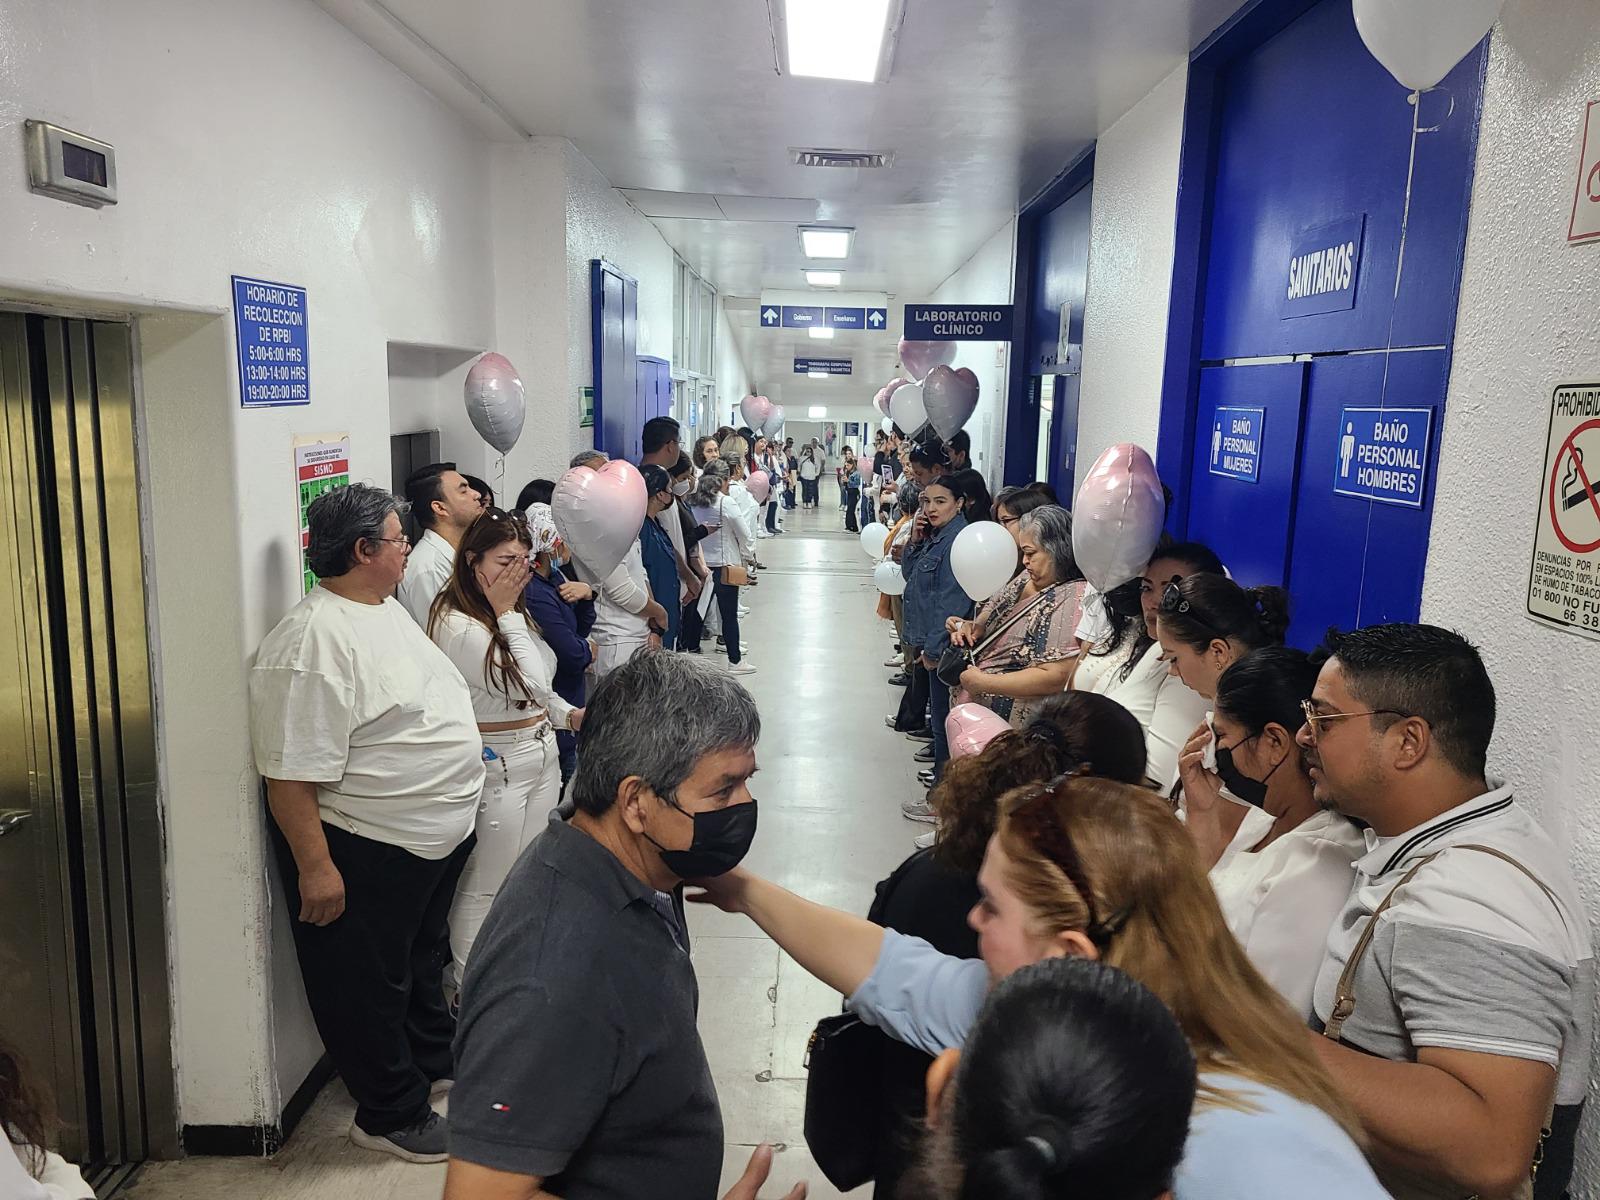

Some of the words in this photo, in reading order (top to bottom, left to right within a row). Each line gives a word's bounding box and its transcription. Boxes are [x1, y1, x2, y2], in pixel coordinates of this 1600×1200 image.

[1288, 241, 1353, 300] SANITARIOS
[247, 284, 285, 305] HORARIO
[287, 291, 298, 307] DE
[243, 304, 303, 326] RECOLECCION
[915, 311, 1002, 322] LABORATORIO
[259, 327, 271, 341] DE
[272, 328, 291, 343] RPBI
[933, 322, 984, 335] CLÍNICO
[249, 345, 284, 361] 5:00-6:00
[286, 347, 301, 362] HRS
[246, 365, 289, 380] 13:00-14:00
[291, 366, 306, 380] HRS
[247, 385, 290, 399] 19:00-20:00
[291, 384, 306, 398] HRS
[1232, 416, 1251, 435] BAÑO
[1373, 418, 1409, 443] BAÑO
[1223, 437, 1257, 455] PERSONAL
[1223, 455, 1253, 474] MUJERES
[1357, 444, 1421, 469] PERSONAL
[314, 463, 334, 476] SISMO
[1357, 467, 1416, 494] HOMBRES
[1537, 551, 1572, 567] DENUNCIAS
[1576, 559, 1591, 571] POR
[1534, 574, 1542, 585] DE
[1543, 577, 1560, 590] HUMO
[1560, 581, 1570, 593] DE
[1535, 563, 1544, 573] EN
[1544, 565, 1574, 581] ESPACIOS
[1576, 573, 1593, 585] 100%
[1532, 587, 1542, 599] 01
[1544, 590, 1561, 604] 800
[1563, 595, 1580, 609] NO
[1564, 609, 1576, 621] 66
